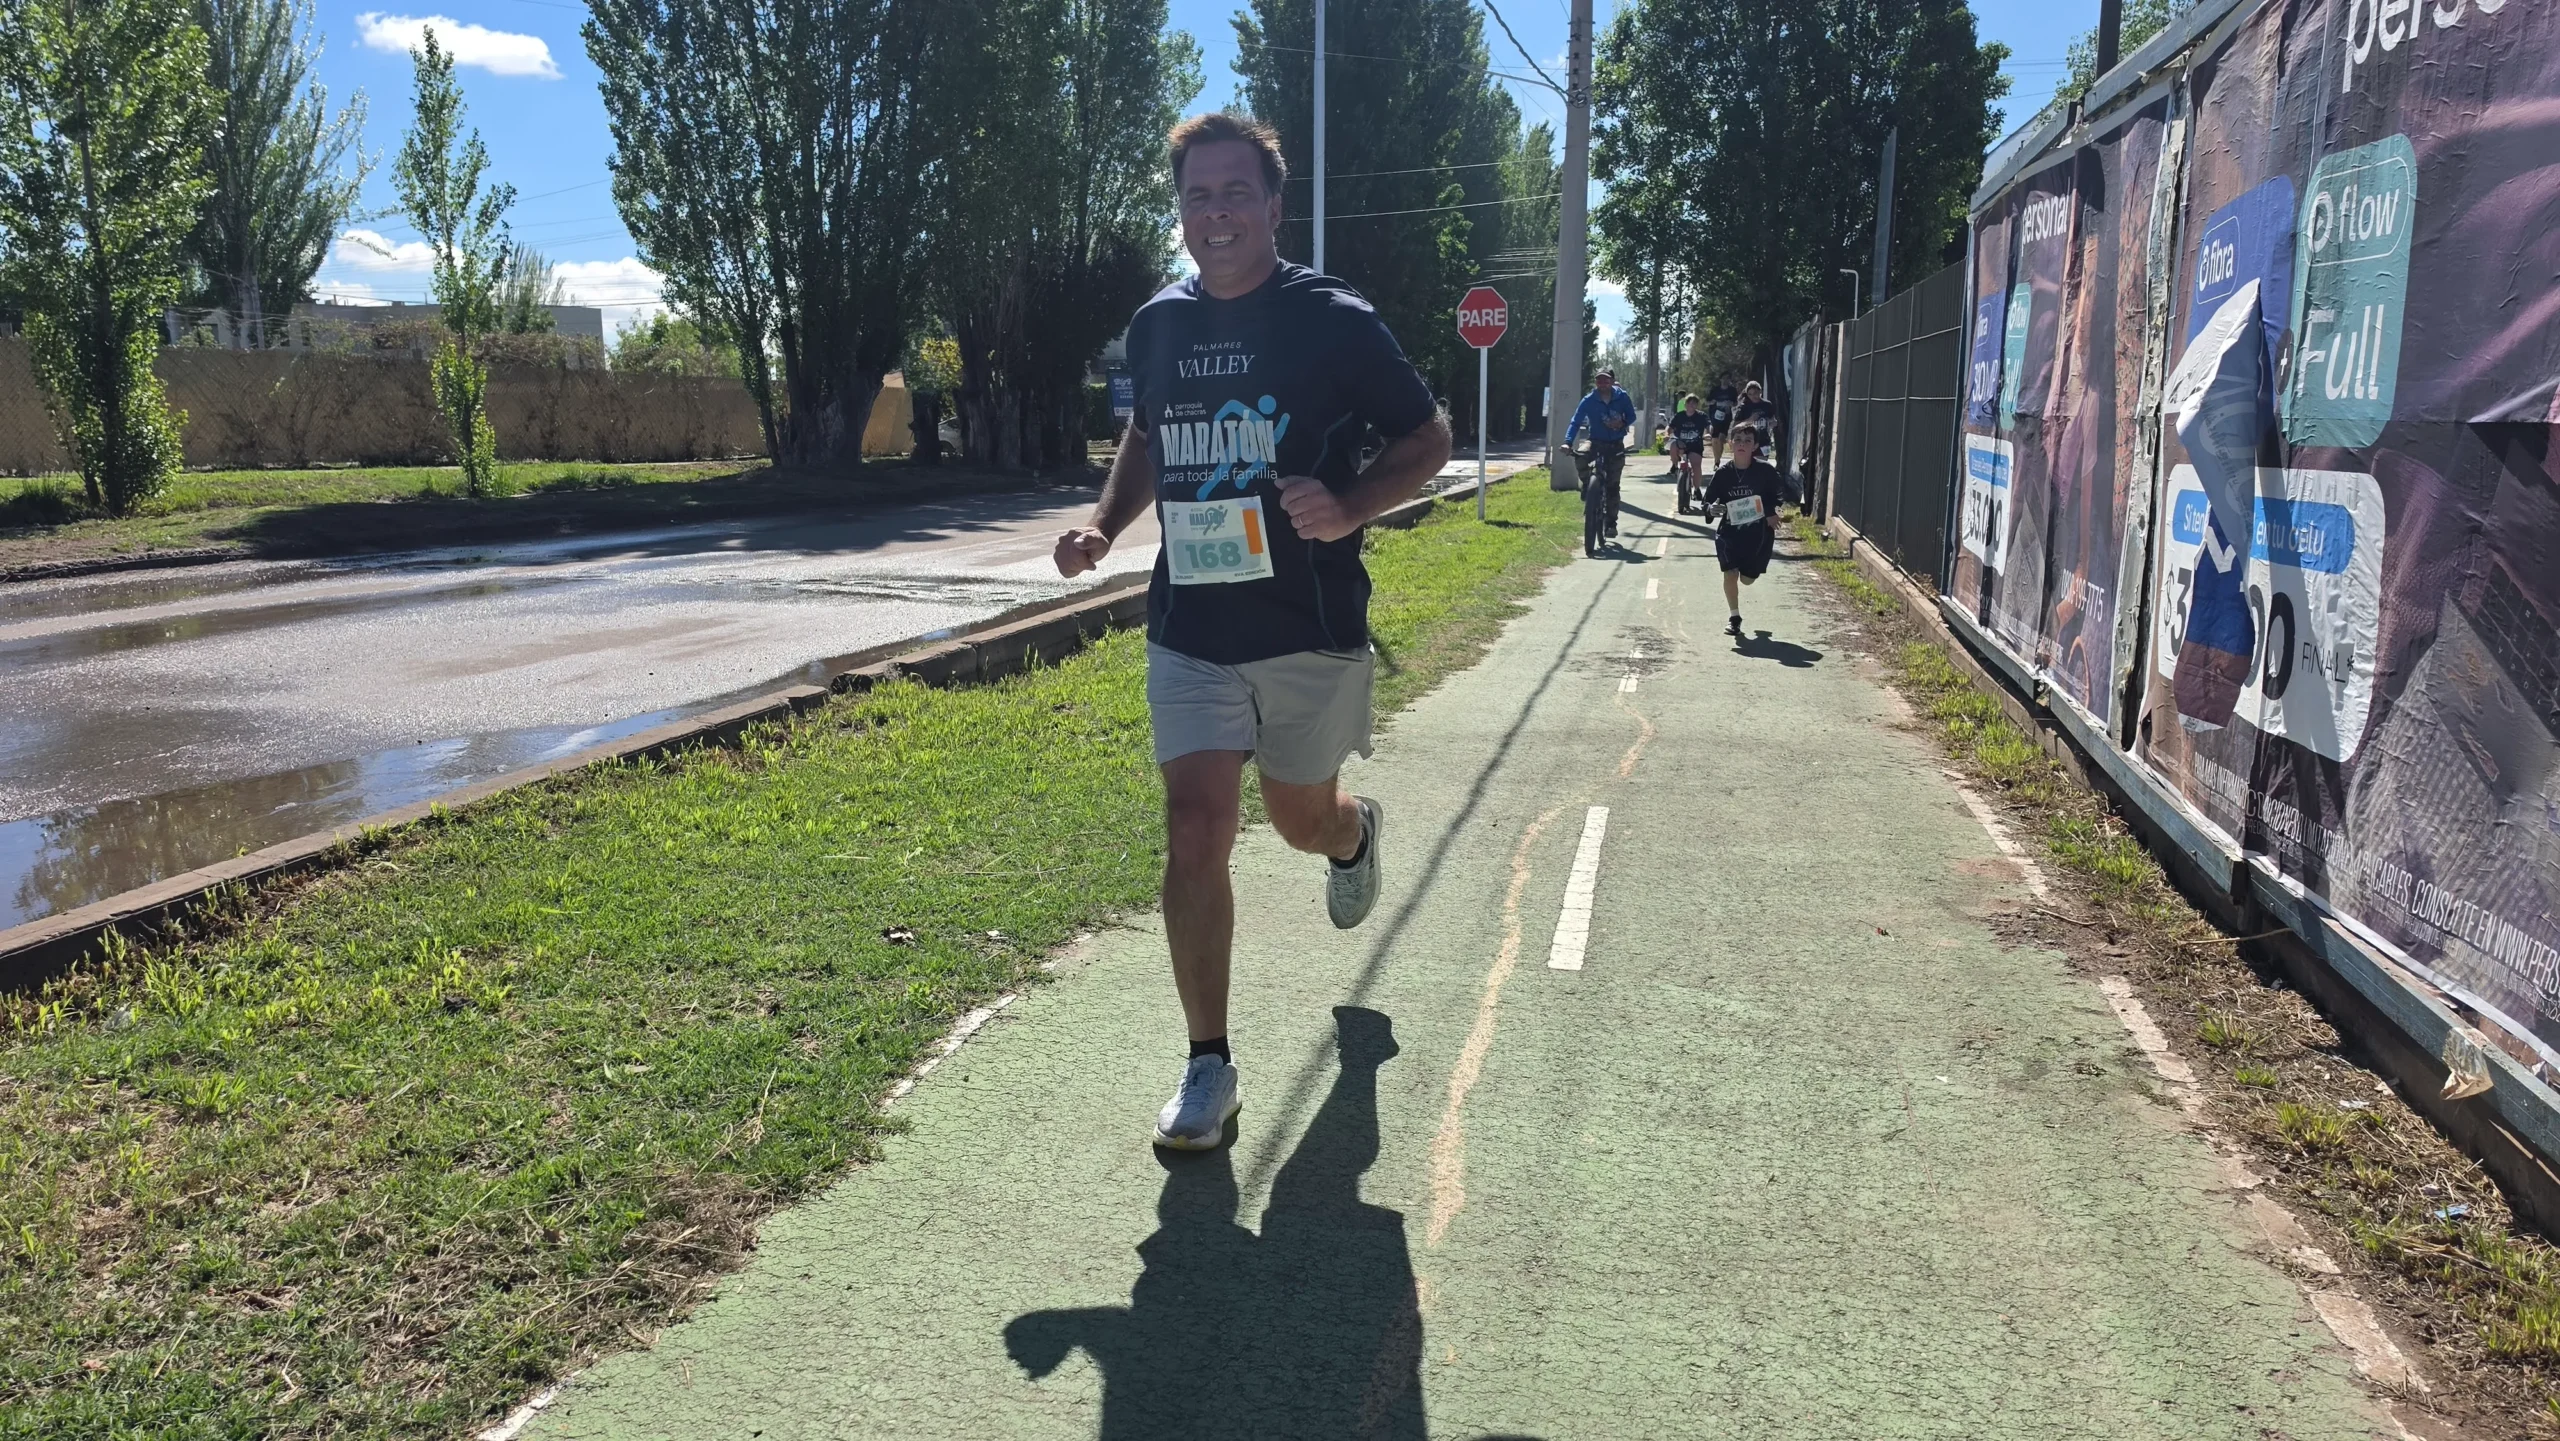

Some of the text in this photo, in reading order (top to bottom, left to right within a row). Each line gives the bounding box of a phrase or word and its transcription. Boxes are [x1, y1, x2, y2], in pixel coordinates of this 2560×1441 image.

[2021, 191, 2069, 257] personal
[2339, 184, 2400, 244] flow
[2209, 238, 2234, 286] fibra
[1460, 308, 1505, 328] PARE
[1193, 341, 1242, 352] PALMARES
[2298, 304, 2385, 400] Full
[1178, 355, 1255, 379] VALLEY
[1175, 401, 1203, 411] parroquia
[1184, 409, 1207, 417] chacras
[1160, 409, 1277, 467] MARATÓN
[1163, 466, 1278, 484] para toda la familia
[1728, 488, 1753, 497] VALLEY
[1736, 508, 1757, 519] 505
[2183, 502, 2191, 530] Si
[2256, 521, 2269, 546] en
[2272, 520, 2286, 550] tu
[2289, 519, 2325, 557] celu
[1185, 541, 1241, 569] 168
[2411, 879, 2480, 942] CONSULTE
[2474, 909, 2498, 954] EN
[2493, 918, 2560, 997] WWW.PERS
